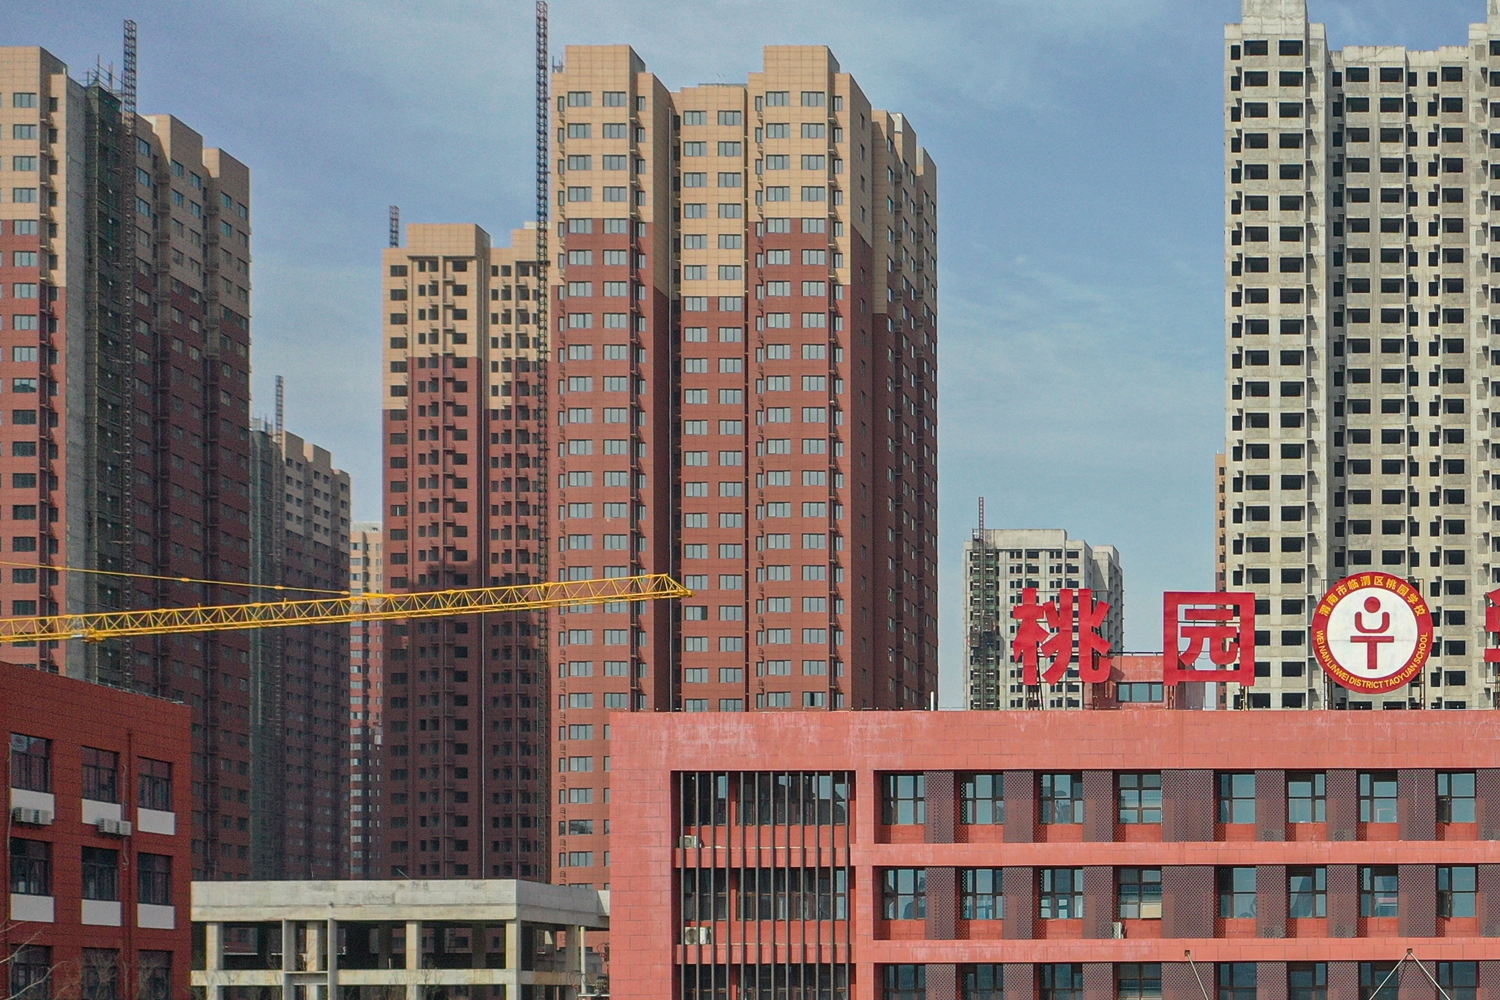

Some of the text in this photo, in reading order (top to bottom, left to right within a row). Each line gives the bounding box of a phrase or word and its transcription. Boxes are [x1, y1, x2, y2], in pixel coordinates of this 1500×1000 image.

[1319, 575, 1426, 616] 渭南市临渭区桃园学校
[1316, 630, 1324, 645] WEI
[1413, 632, 1428, 664] SCHOOL
[1318, 645, 1331, 663] NAN
[1348, 676, 1384, 689] DISTRICT
[1383, 662, 1418, 688] TAOYUAN
